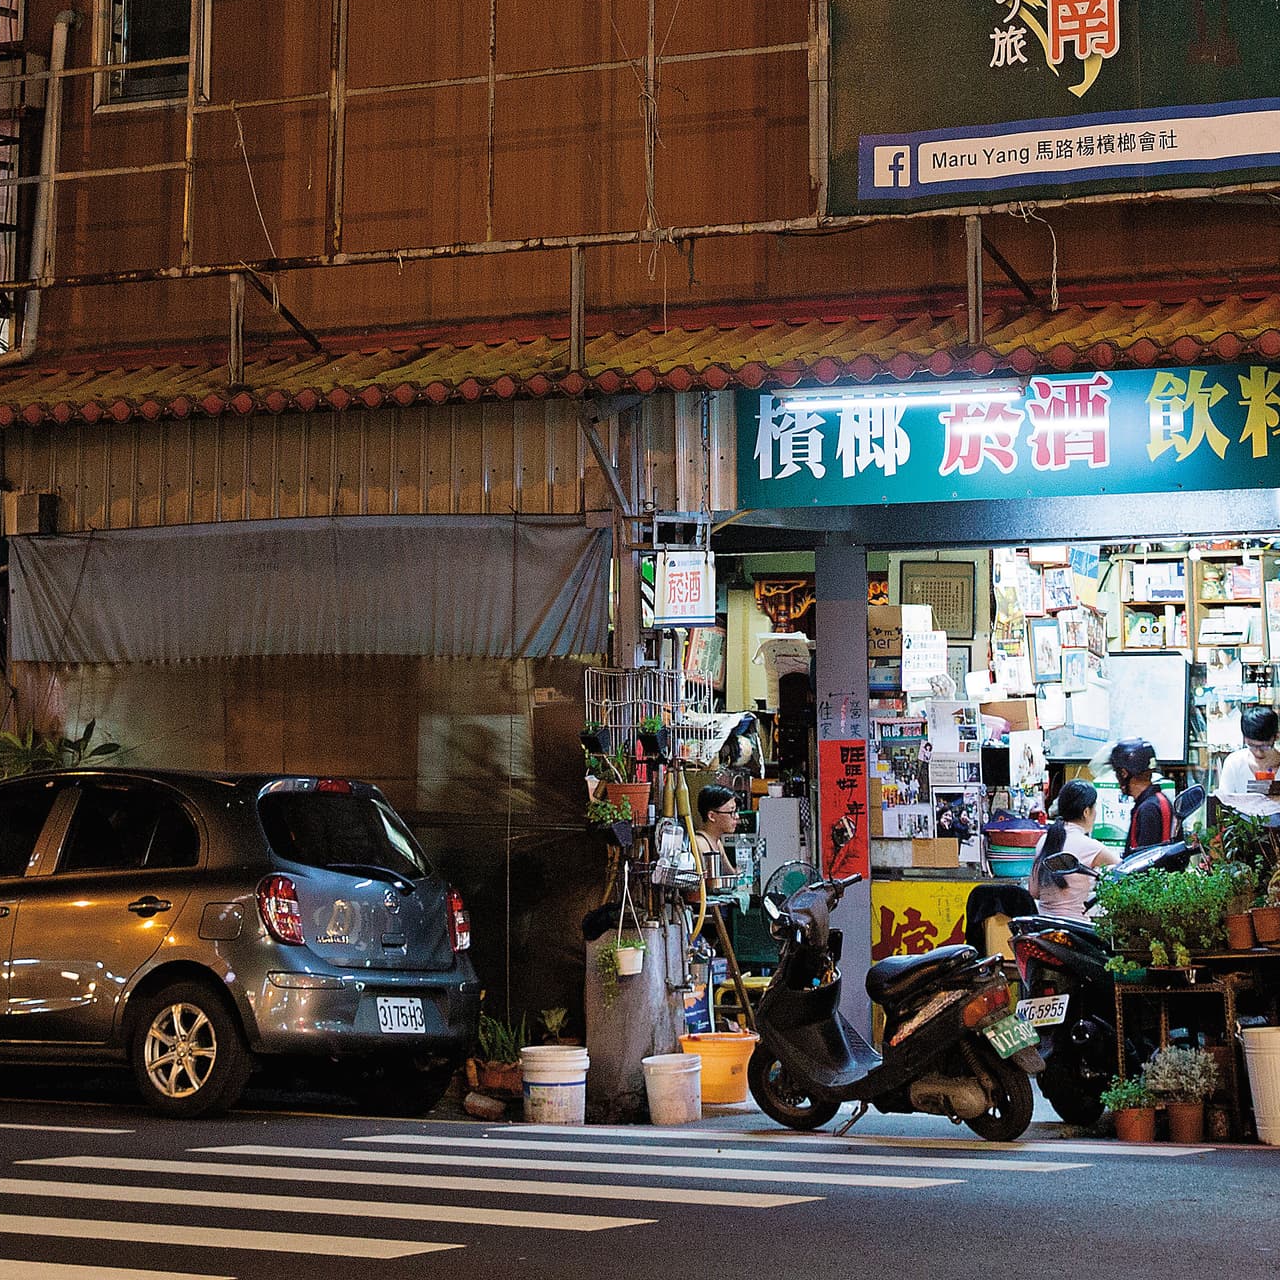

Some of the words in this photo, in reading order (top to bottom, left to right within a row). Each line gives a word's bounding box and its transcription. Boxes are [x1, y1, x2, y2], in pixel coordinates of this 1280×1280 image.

[932, 151, 977, 170] Maru
[982, 146, 1030, 166] Yang
[1035, 129, 1179, 161] 馬路楊檳榔會社
[753, 392, 912, 480] 檳榔
[668, 571, 702, 605] 菸酒
